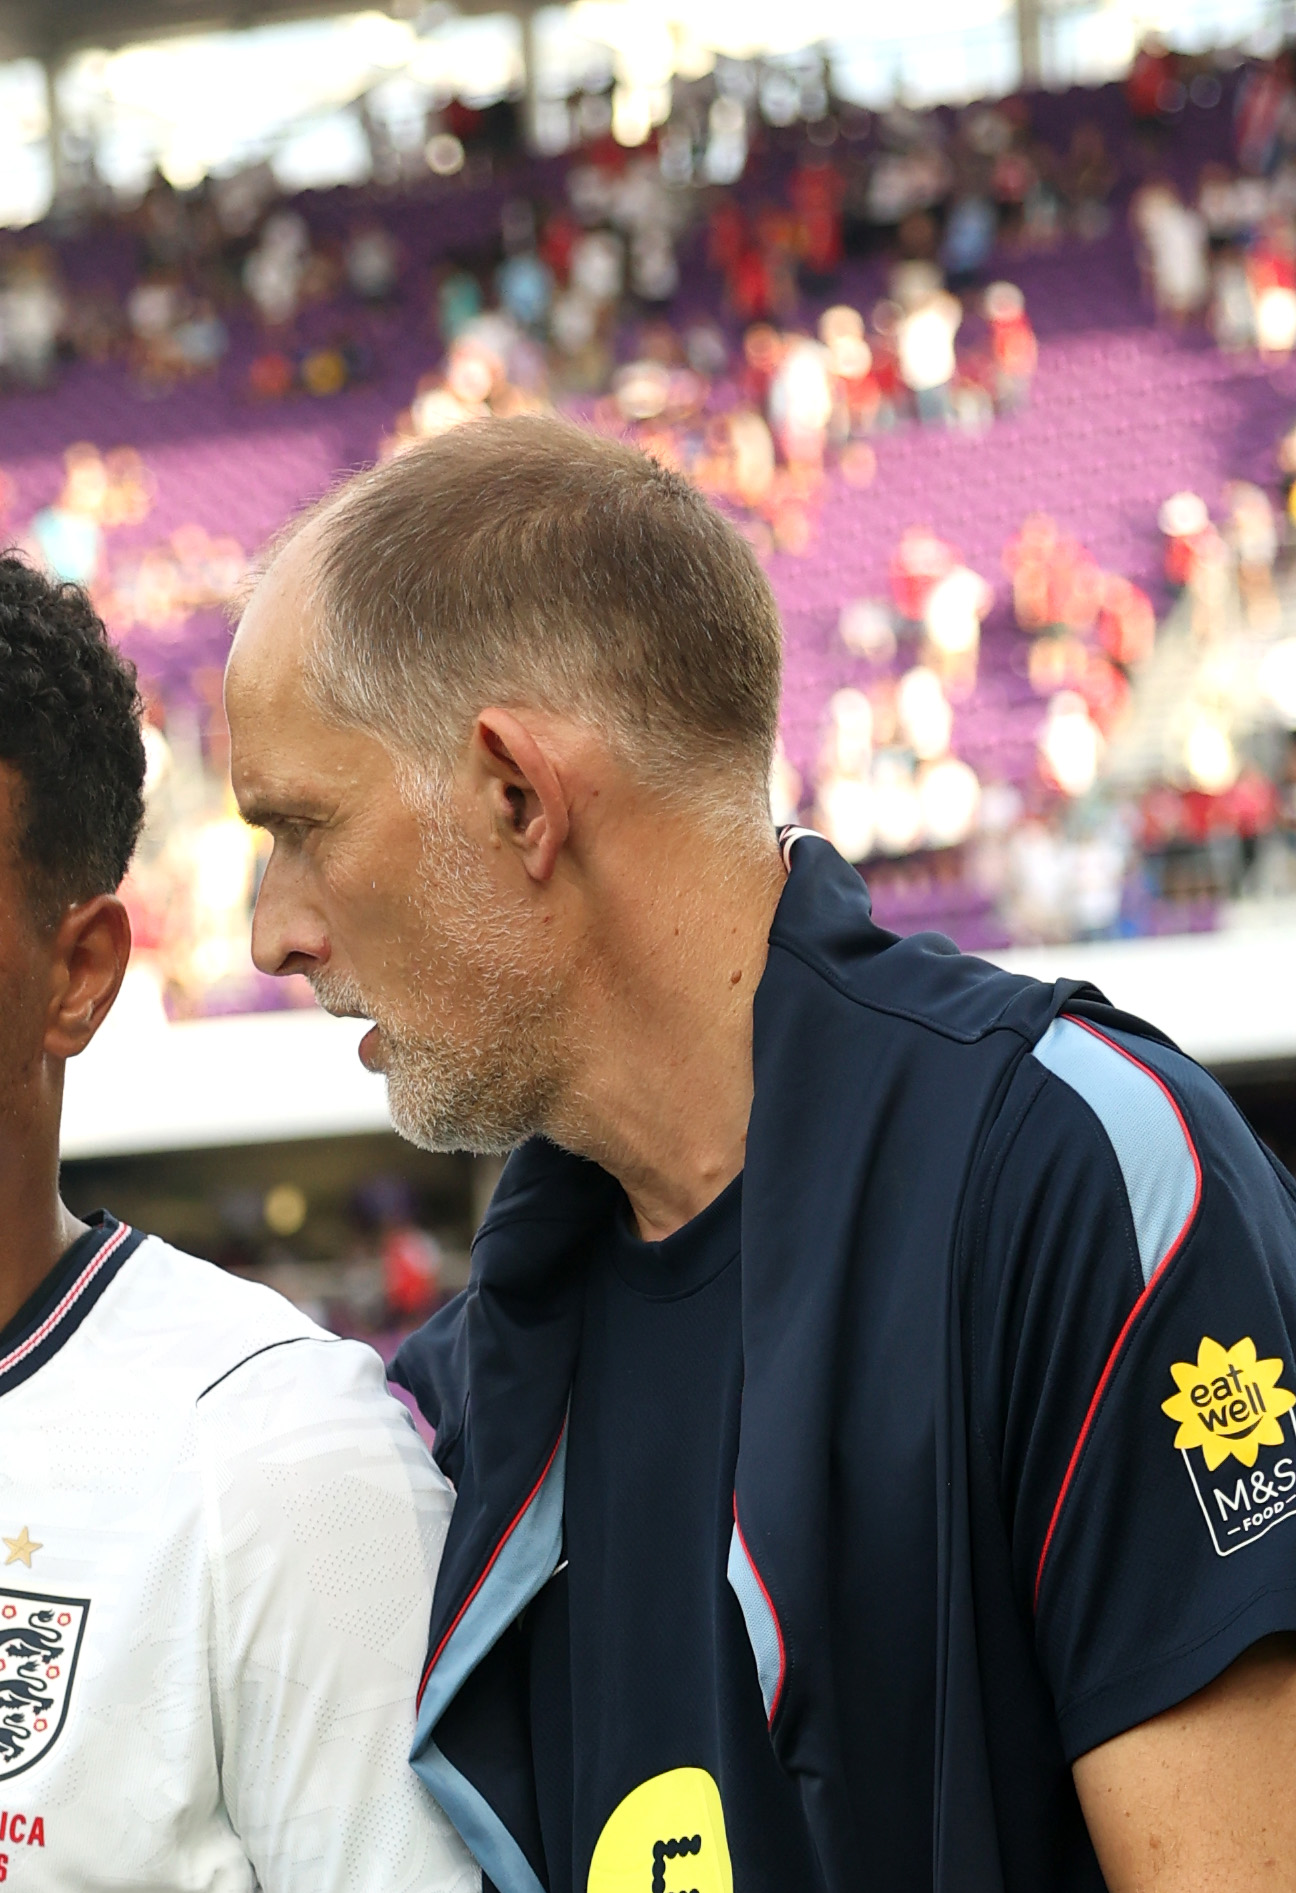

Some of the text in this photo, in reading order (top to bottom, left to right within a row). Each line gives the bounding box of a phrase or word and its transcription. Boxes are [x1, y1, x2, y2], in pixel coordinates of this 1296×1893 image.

[1190, 1364, 1243, 1408] eat
[1197, 1382, 1267, 1432] well
[1213, 1458, 1296, 1521] M&S
[1242, 1501, 1285, 1532] FOOD
